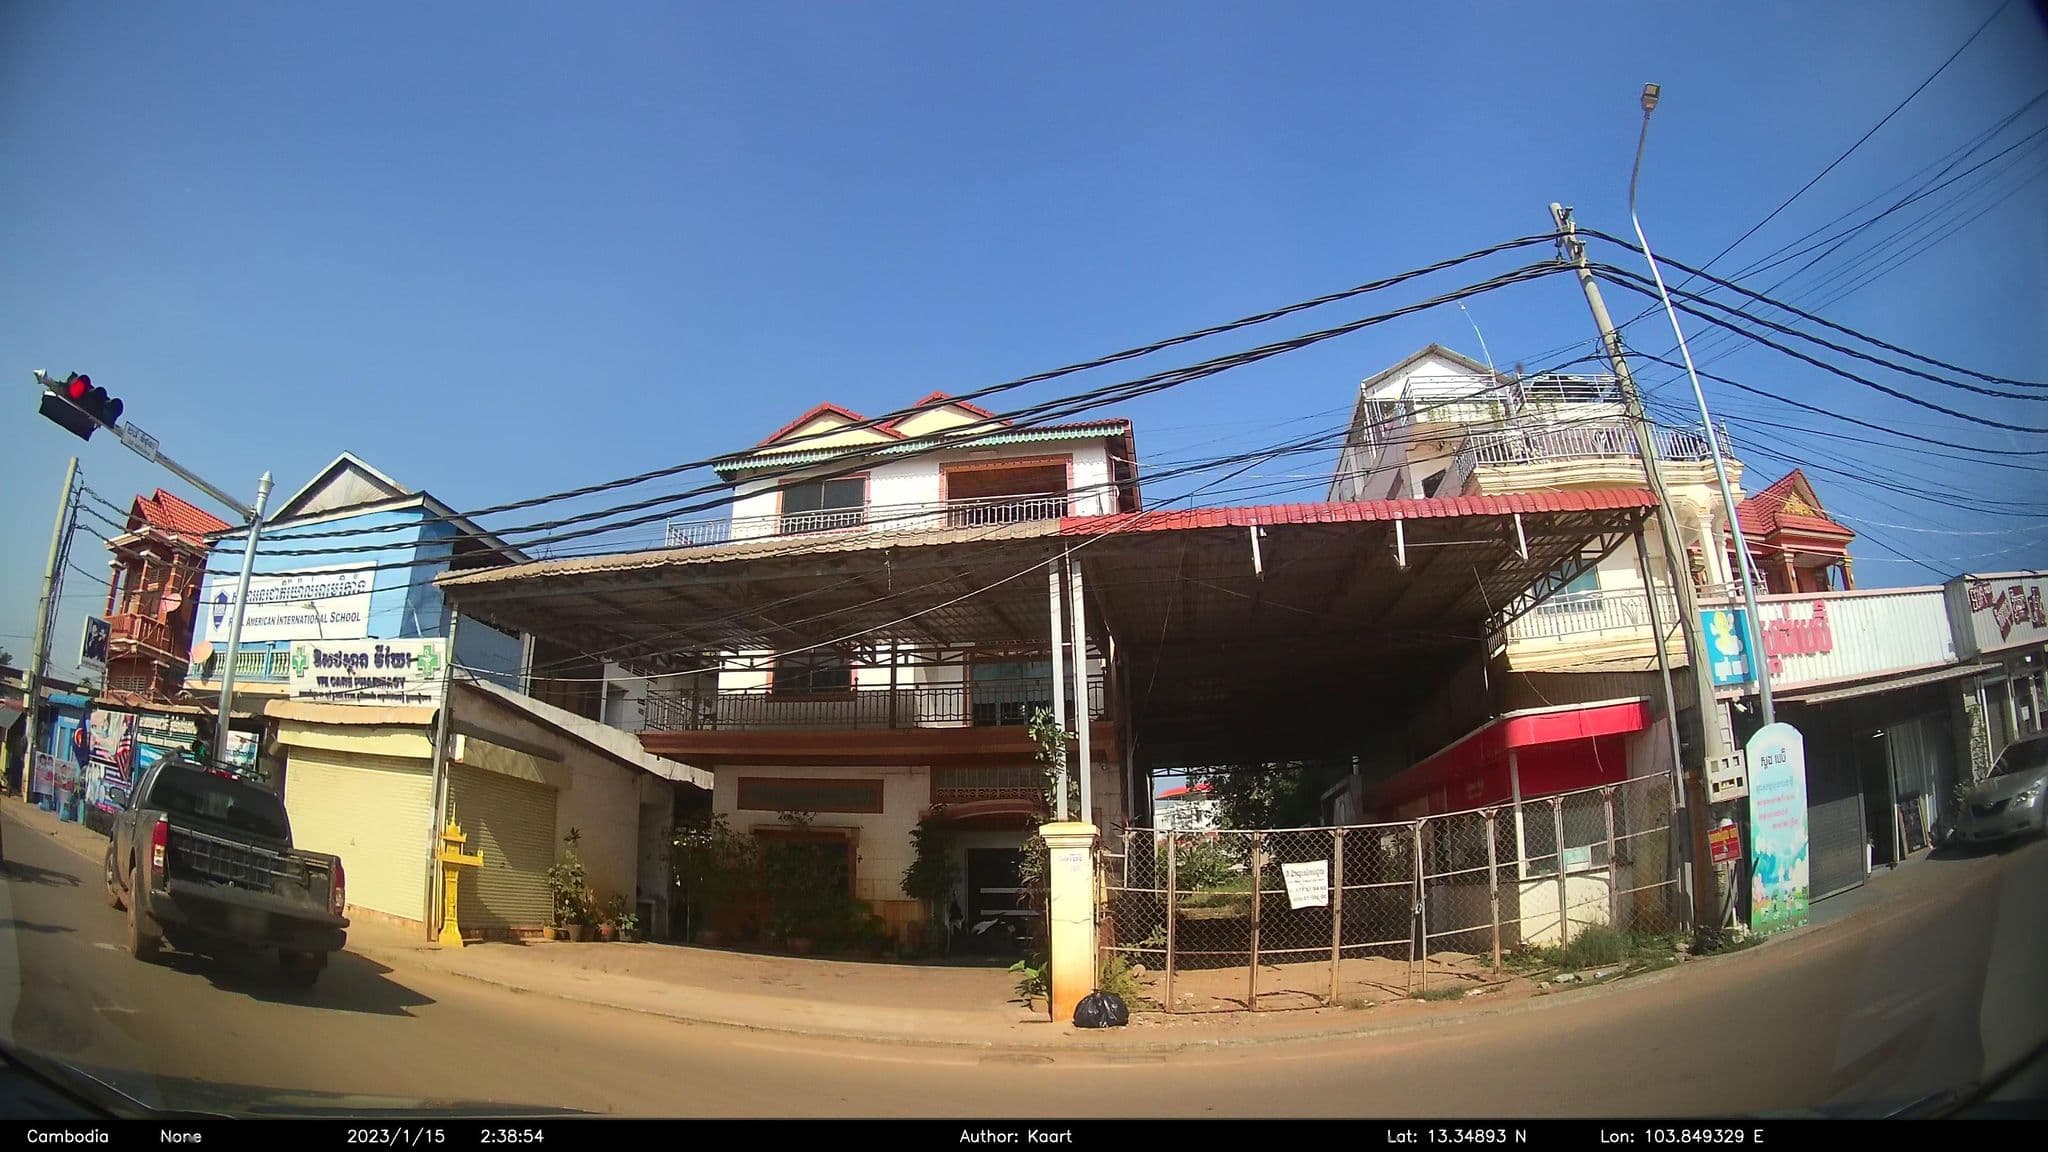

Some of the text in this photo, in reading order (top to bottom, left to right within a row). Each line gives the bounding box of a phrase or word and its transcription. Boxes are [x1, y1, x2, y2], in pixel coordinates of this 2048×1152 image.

[245, 616, 277, 627] AMERICAN
[277, 614, 328, 626] INTERNATIONAL
[330, 611, 361, 623] SCHOOL
[354, 676, 406, 689] PHARMACY
